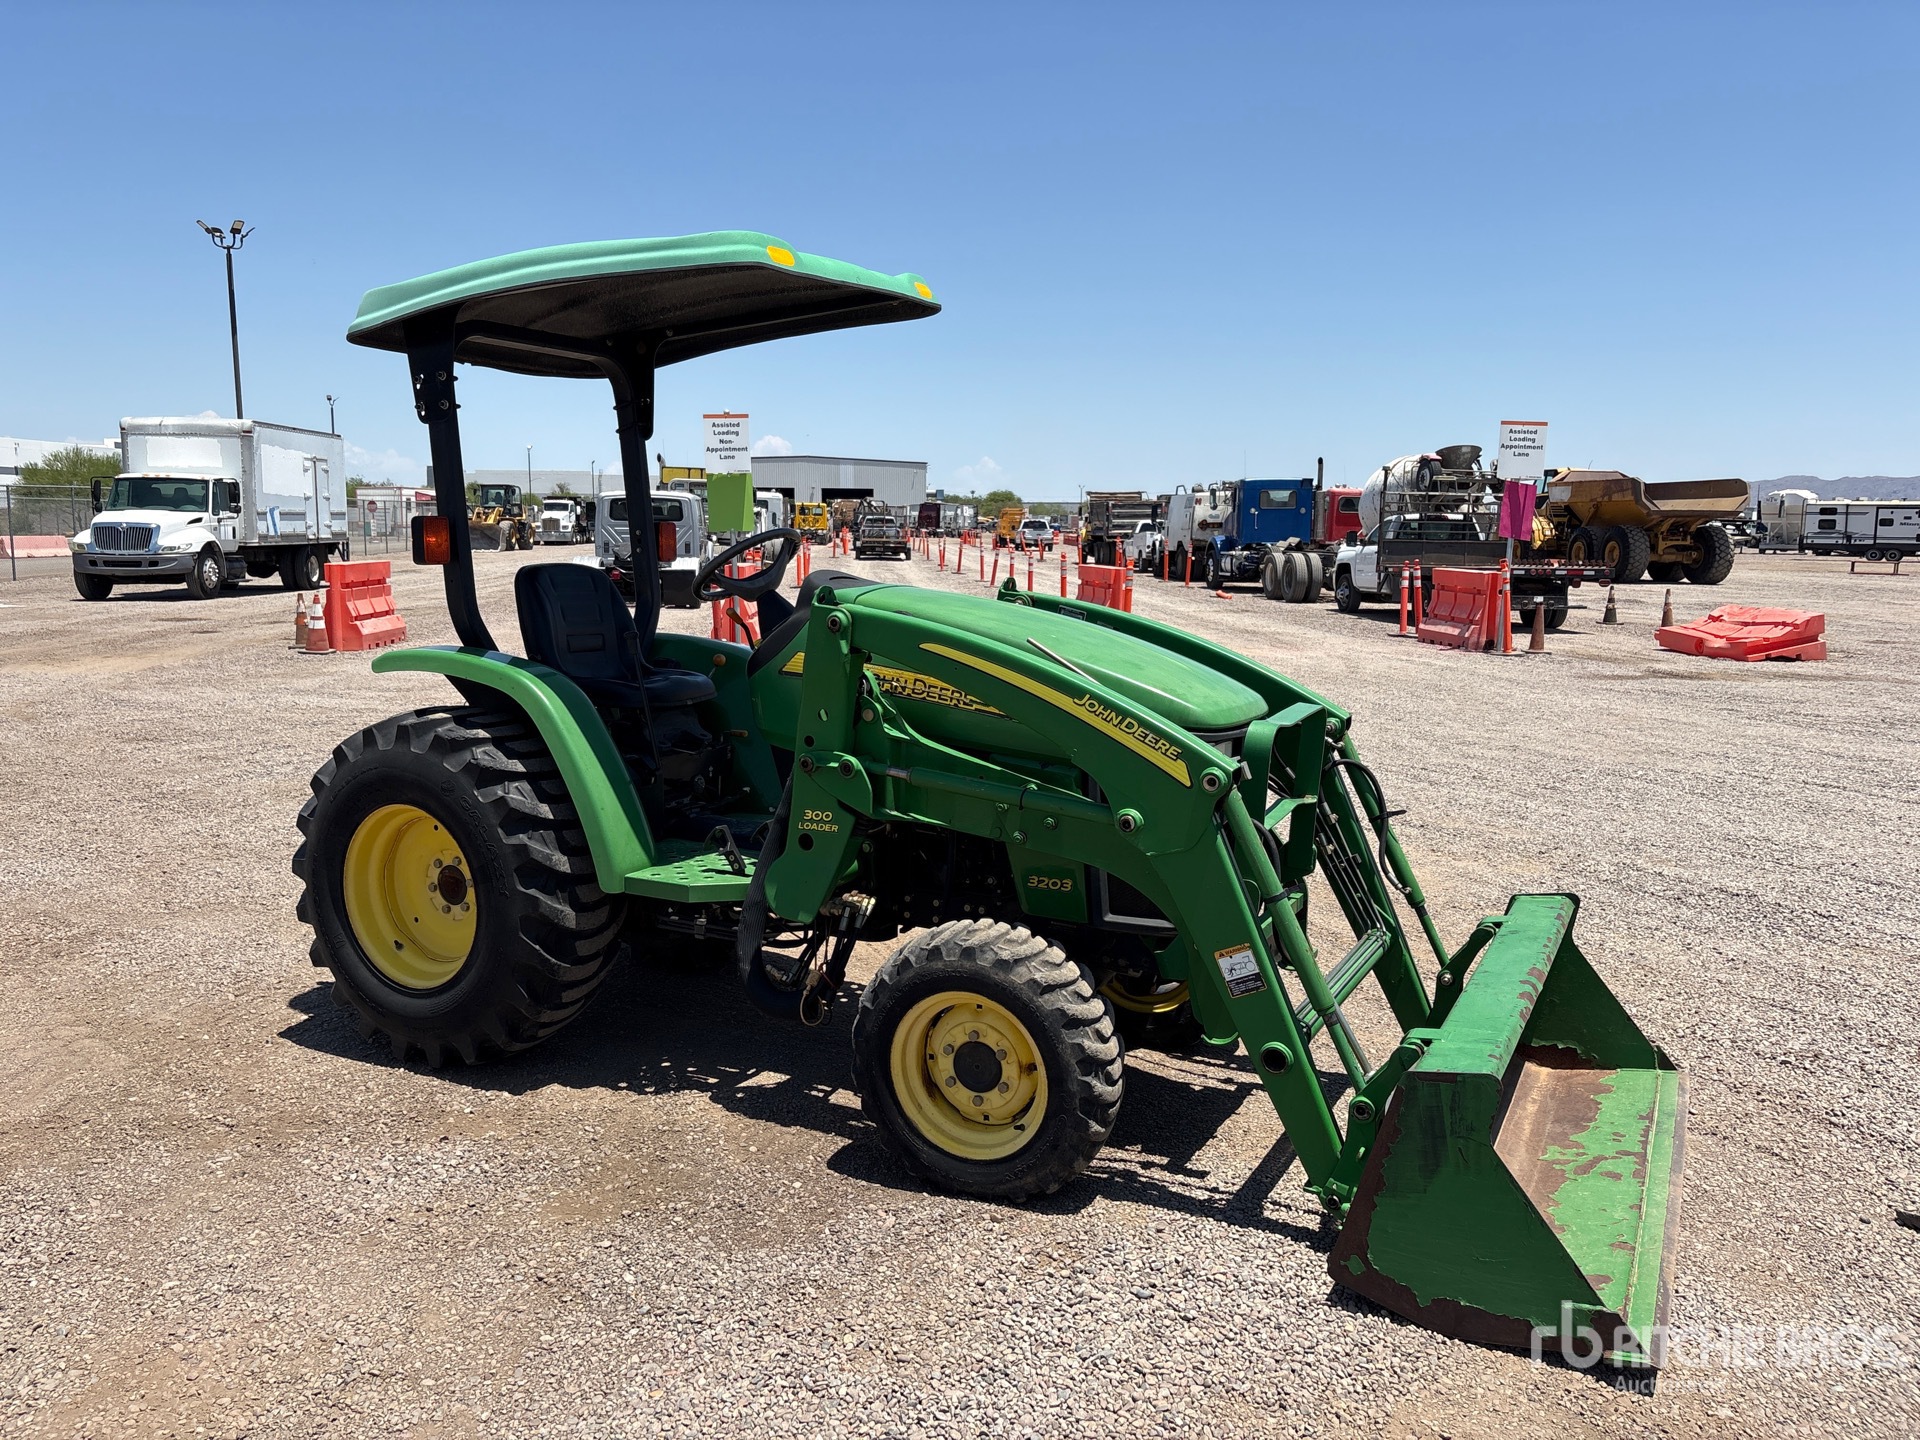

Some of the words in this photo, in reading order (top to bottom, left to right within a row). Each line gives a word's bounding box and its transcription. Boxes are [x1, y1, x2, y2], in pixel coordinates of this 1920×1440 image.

[1072, 693, 1122, 728] JOHN
[1119, 716, 1183, 761] DEERE
[803, 809, 833, 822] 300
[798, 821, 839, 833] LOADER
[459, 795, 511, 898] GALAXY
[1027, 875, 1073, 892] 3203
